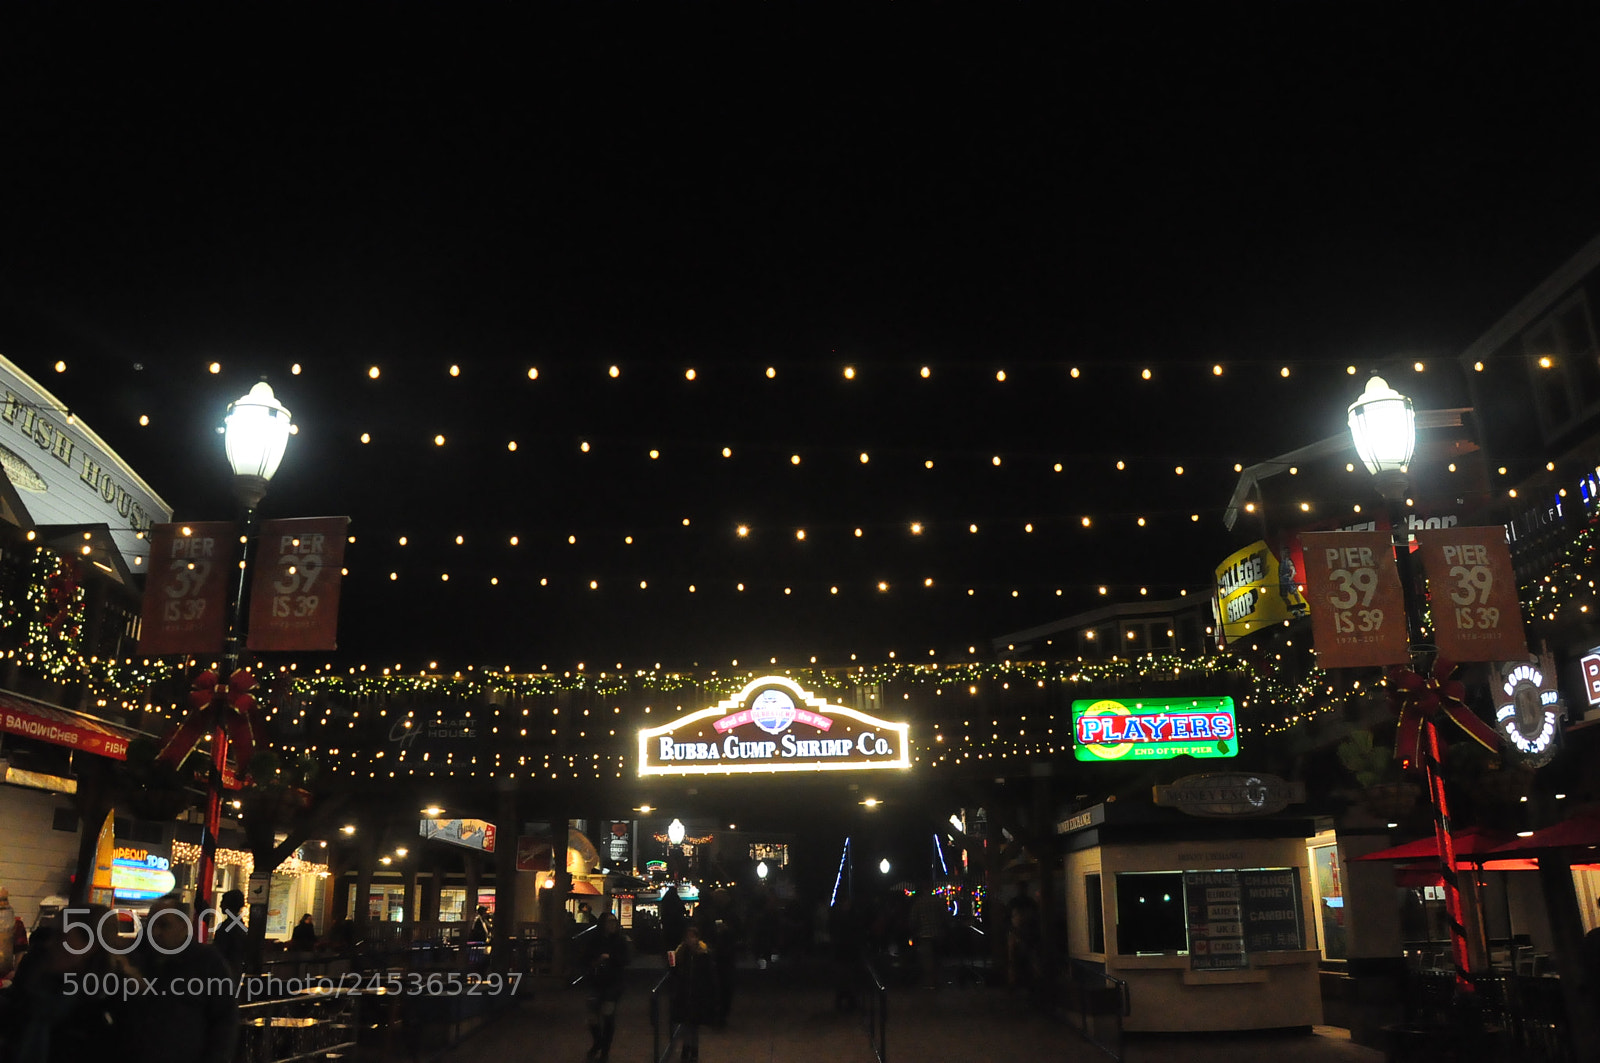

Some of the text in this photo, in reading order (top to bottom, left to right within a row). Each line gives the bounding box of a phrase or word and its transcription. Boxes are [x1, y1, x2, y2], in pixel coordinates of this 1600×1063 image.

[2, 391, 74, 468] FISH
[171, 537, 215, 559] PIER
[279, 533, 325, 555] PIER
[1442, 544, 1490, 565] PIER
[1326, 547, 1375, 569] PIER
[165, 559, 212, 598] 39
[273, 554, 322, 594] 39
[1329, 567, 1378, 609] 39
[1449, 566, 1493, 605] 39
[163, 599, 206, 621] IS 39
[272, 595, 319, 617] IS 39
[1226, 591, 1255, 622] SHOP
[1334, 608, 1384, 634] IS 39
[1455, 607, 1500, 629] IS 39
[720, 712, 830, 729] End of the Pier
[1082, 716, 1231, 741] PLAYERS
[6, 715, 78, 744] SANDWICHES
[104, 741, 127, 754] FISH
[428, 730, 477, 738] HOUSE
[659, 736, 720, 760] BUBBA
[723, 735, 776, 759] GUMP
[781, 734, 853, 758] SHRIMP
[1134, 746, 1212, 756] END OF THE PIER
[1249, 887, 1289, 898] MONEY
[1249, 909, 1296, 921] CAMBIO
